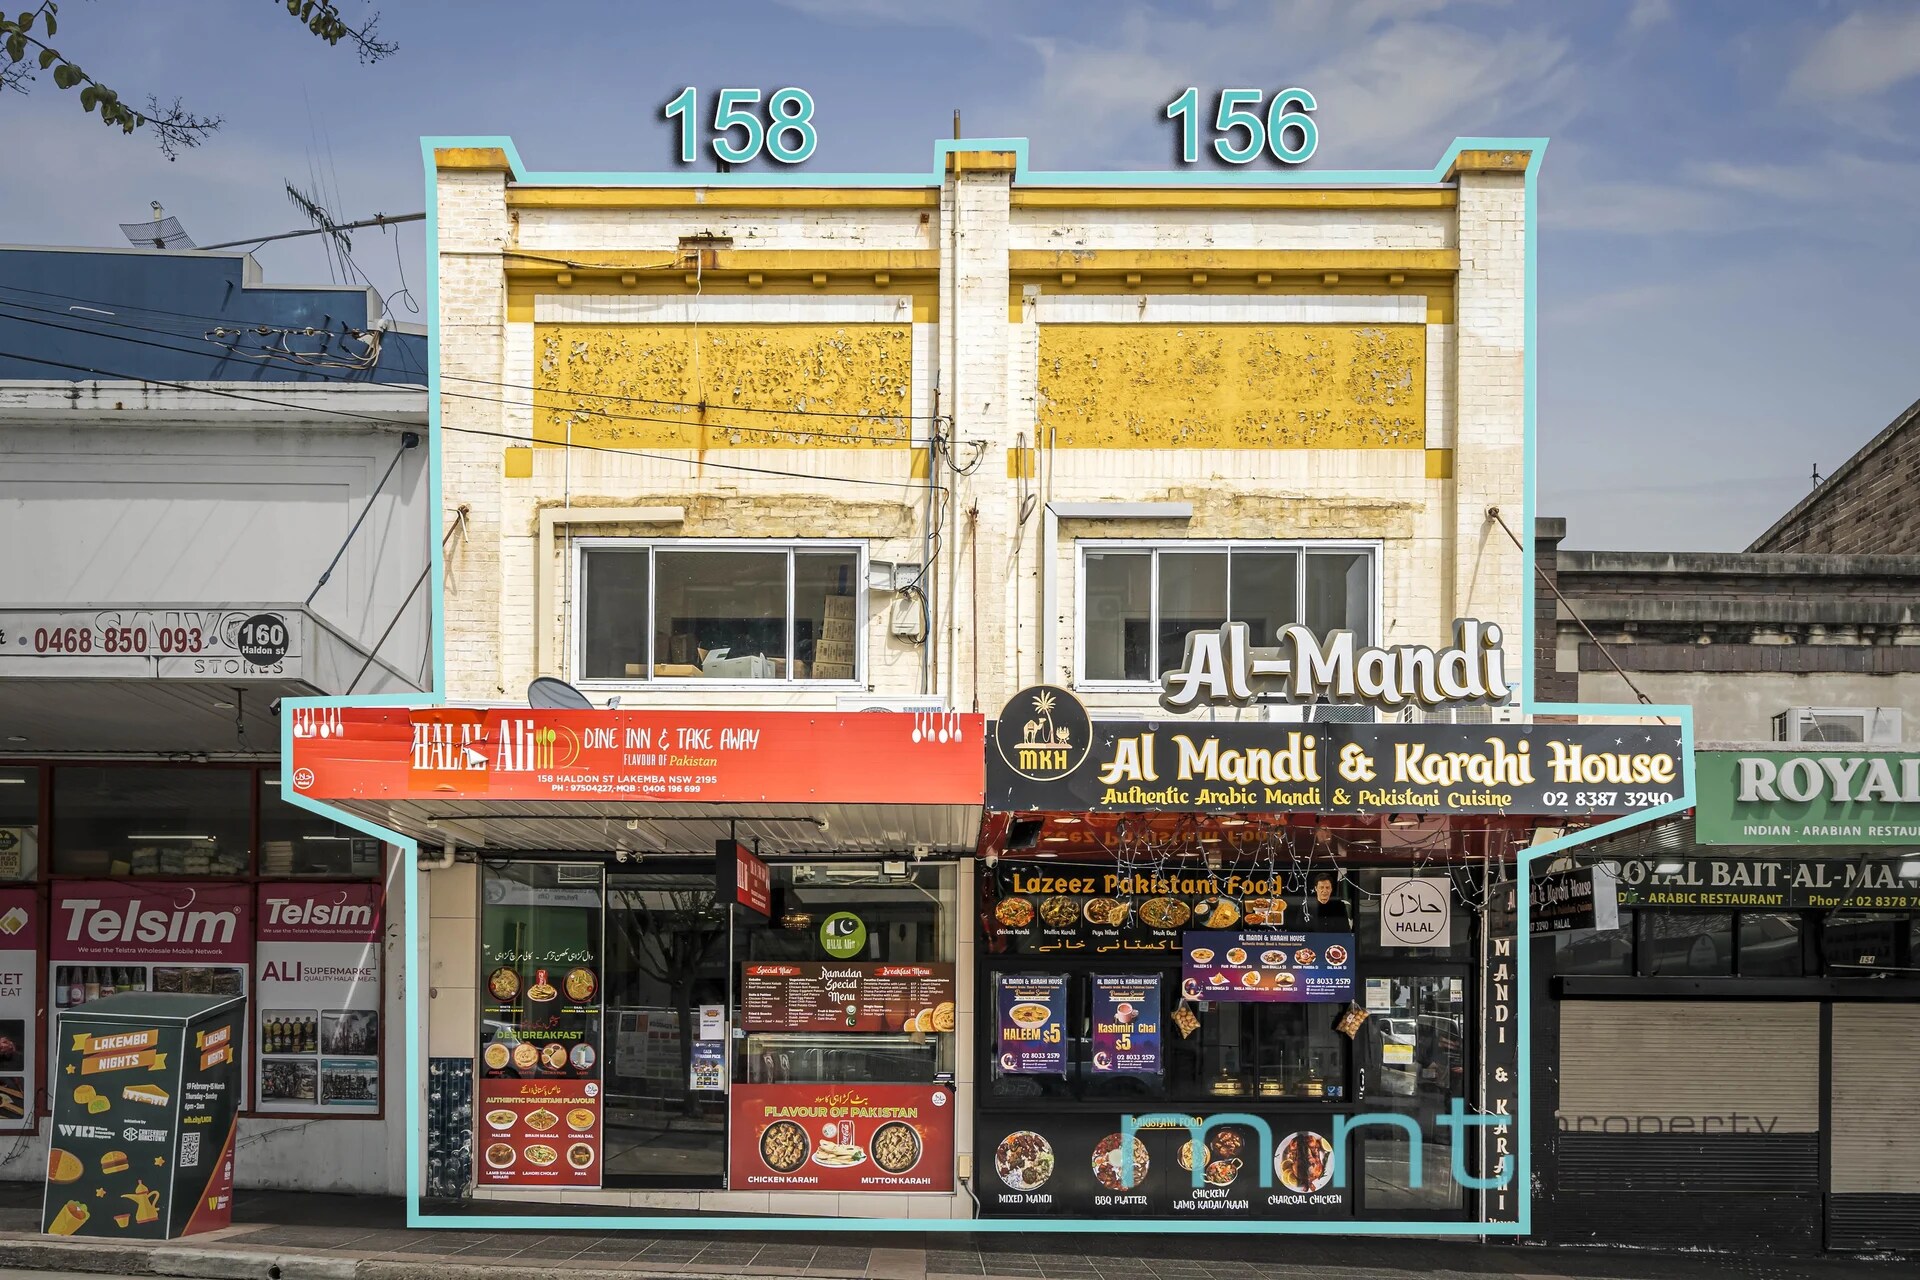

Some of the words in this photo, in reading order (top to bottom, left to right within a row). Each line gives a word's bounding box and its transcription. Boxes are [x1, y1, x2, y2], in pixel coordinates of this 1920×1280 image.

[34, 628, 92, 653] 0468
[104, 628, 147, 653] 850
[159, 628, 202, 653] 093
[243, 624, 284, 646] 160
[242, 645, 273, 655] Haldon
[275, 646, 285, 655] st
[1167, 620, 1511, 706] Al-Mandi
[495, 719, 535, 771] Ali
[583, 728, 619, 749] DINE
[625, 728, 651, 749] INN
[658, 728, 670, 750] &
[676, 728, 714, 750] TAKE
[719, 728, 761, 750] AWAY
[624, 753, 656, 766] FLAVOUR
[658, 754, 668, 766] OF
[669, 755, 718, 767] Pakistan
[1019, 749, 1068, 770] MKH
[1098, 732, 1159, 785] Al
[1171, 731, 1322, 786] Mandi
[1338, 742, 1377, 783] &
[1394, 736, 1536, 787] Karahi
[1546, 740, 1676, 785] House
[537, 775, 553, 783] 158
[556, 775, 600, 783] HALDON
[603, 775, 614, 783] ST
[618, 775, 666, 784] LAKEMBA
[669, 776, 692, 784] NSW
[695, 776, 717, 784] 2195
[1101, 785, 1189, 805] Authentic
[1194, 787, 1257, 805] Arabic
[1264, 787, 1321, 805] Mandi
[1332, 788, 1351, 806] &
[1358, 788, 1441, 807] Pakistani
[1448, 791, 1512, 807] Cuisine
[1542, 791, 1569, 807] 02
[1575, 791, 1617, 807] 8387
[1624, 791, 1674, 807] 3240
[1744, 825, 1791, 836] INDIAN
[1802, 825, 1861, 836] ARABIAN
[1013, 873, 1095, 894] Lazeez
[1104, 873, 1218, 894] Pakistani
[1227, 874, 1282, 895] Food
[1571, 879, 1592, 897] House
[266, 890, 372, 925] Telsim
[1389, 893, 1442, 917] حلال
[1649, 893, 1698, 904] ARABIC
[1701, 893, 1783, 905] RESTAURANT
[1856, 897, 1871, 907] 02
[1876, 897, 1907, 907] 8378
[61, 887, 237, 943] Telsim
[1396, 922, 1434, 932] HALAL
[1096, 939, 1183, 952] اکستانی
[261, 961, 302, 982] ALI
[818, 966, 862, 981] Ramadan
[883, 967, 911, 976] Breakfast
[911, 967, 930, 977] Menu
[825, 979, 858, 991] Special
[1493, 939, 1510, 1043] MANDI
[828, 991, 856, 1005] Menu
[496, 1031, 520, 1039] DESI
[522, 1031, 583, 1039] BREAKFAST
[1003, 1028, 1040, 1041] HALEEM
[1043, 1023, 1061, 1043] $5
[1098, 1023, 1134, 1033] Kashmiri
[1138, 1023, 1156, 1033] Chai
[94, 1033, 148, 1051] LAKEMBA
[1115, 1034, 1131, 1051] $5
[99, 1054, 139, 1070] NIGHTS
[1495, 1067, 1508, 1083] &
[764, 1106, 827, 1117] FLAVOUR
[830, 1106, 849, 1118] OF
[851, 1107, 918, 1118] PAKISTAN
[1179, 1116, 1203, 1127] FOOD
[747, 1176, 785, 1184] CHICKEN
[786, 1176, 818, 1184] KARAHI
[861, 1176, 897, 1184] MUTTON
[998, 1193, 1023, 1203] MIXED
[1025, 1194, 1052, 1204] MANDI
[1095, 1195, 1112, 1205] BBQ
[1114, 1195, 1148, 1205] PLATTER
[1192, 1188, 1230, 1199] CHICKEN/
[1268, 1194, 1307, 1205] CHARCOAL
[1309, 1194, 1342, 1204] CHICKEN
[1173, 1199, 1196, 1210] LAMB
